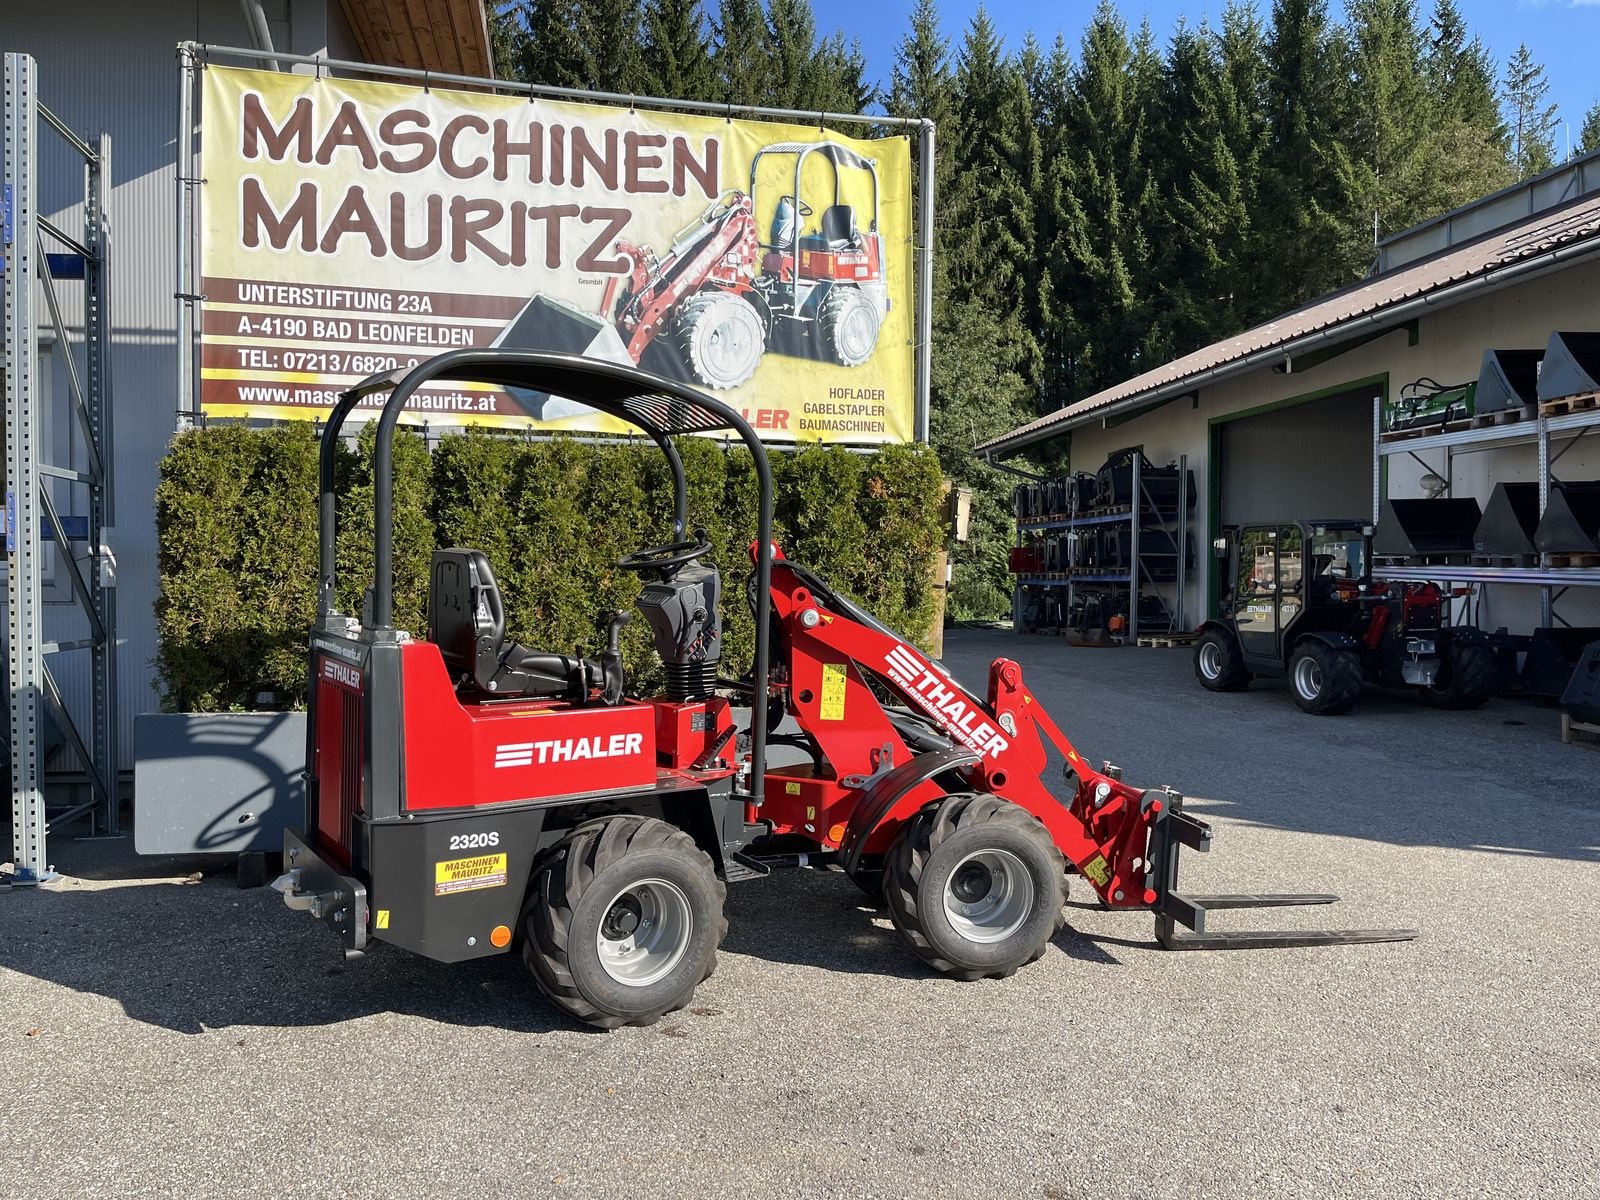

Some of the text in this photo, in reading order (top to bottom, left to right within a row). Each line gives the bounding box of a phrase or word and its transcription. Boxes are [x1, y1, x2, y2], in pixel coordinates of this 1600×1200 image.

[242, 92, 719, 199] MASCHINEN
[242, 177, 632, 274] MAURITZ
[577, 277, 603, 286] GesmbH
[238, 283, 433, 313] UNTERSTIFTUNG 23A
[238, 315, 474, 346] A-4190 BAD LEONFELDEN
[238, 348, 278, 368] TEL:
[829, 387, 885, 401] HOFLADER
[803, 402, 885, 417] GABELSTAPLER
[799, 418, 885, 432] BAUMASCHINEN
[332, 663, 360, 689] THALER
[887, 668, 987, 757] www.maschinen-mauritz.at
[916, 669, 1010, 759] THALER
[534, 733, 643, 764] THALER
[449, 831, 500, 850] 2320S
[445, 856, 500, 872] MASCHINEN
[451, 866, 493, 880] MAURITZ
